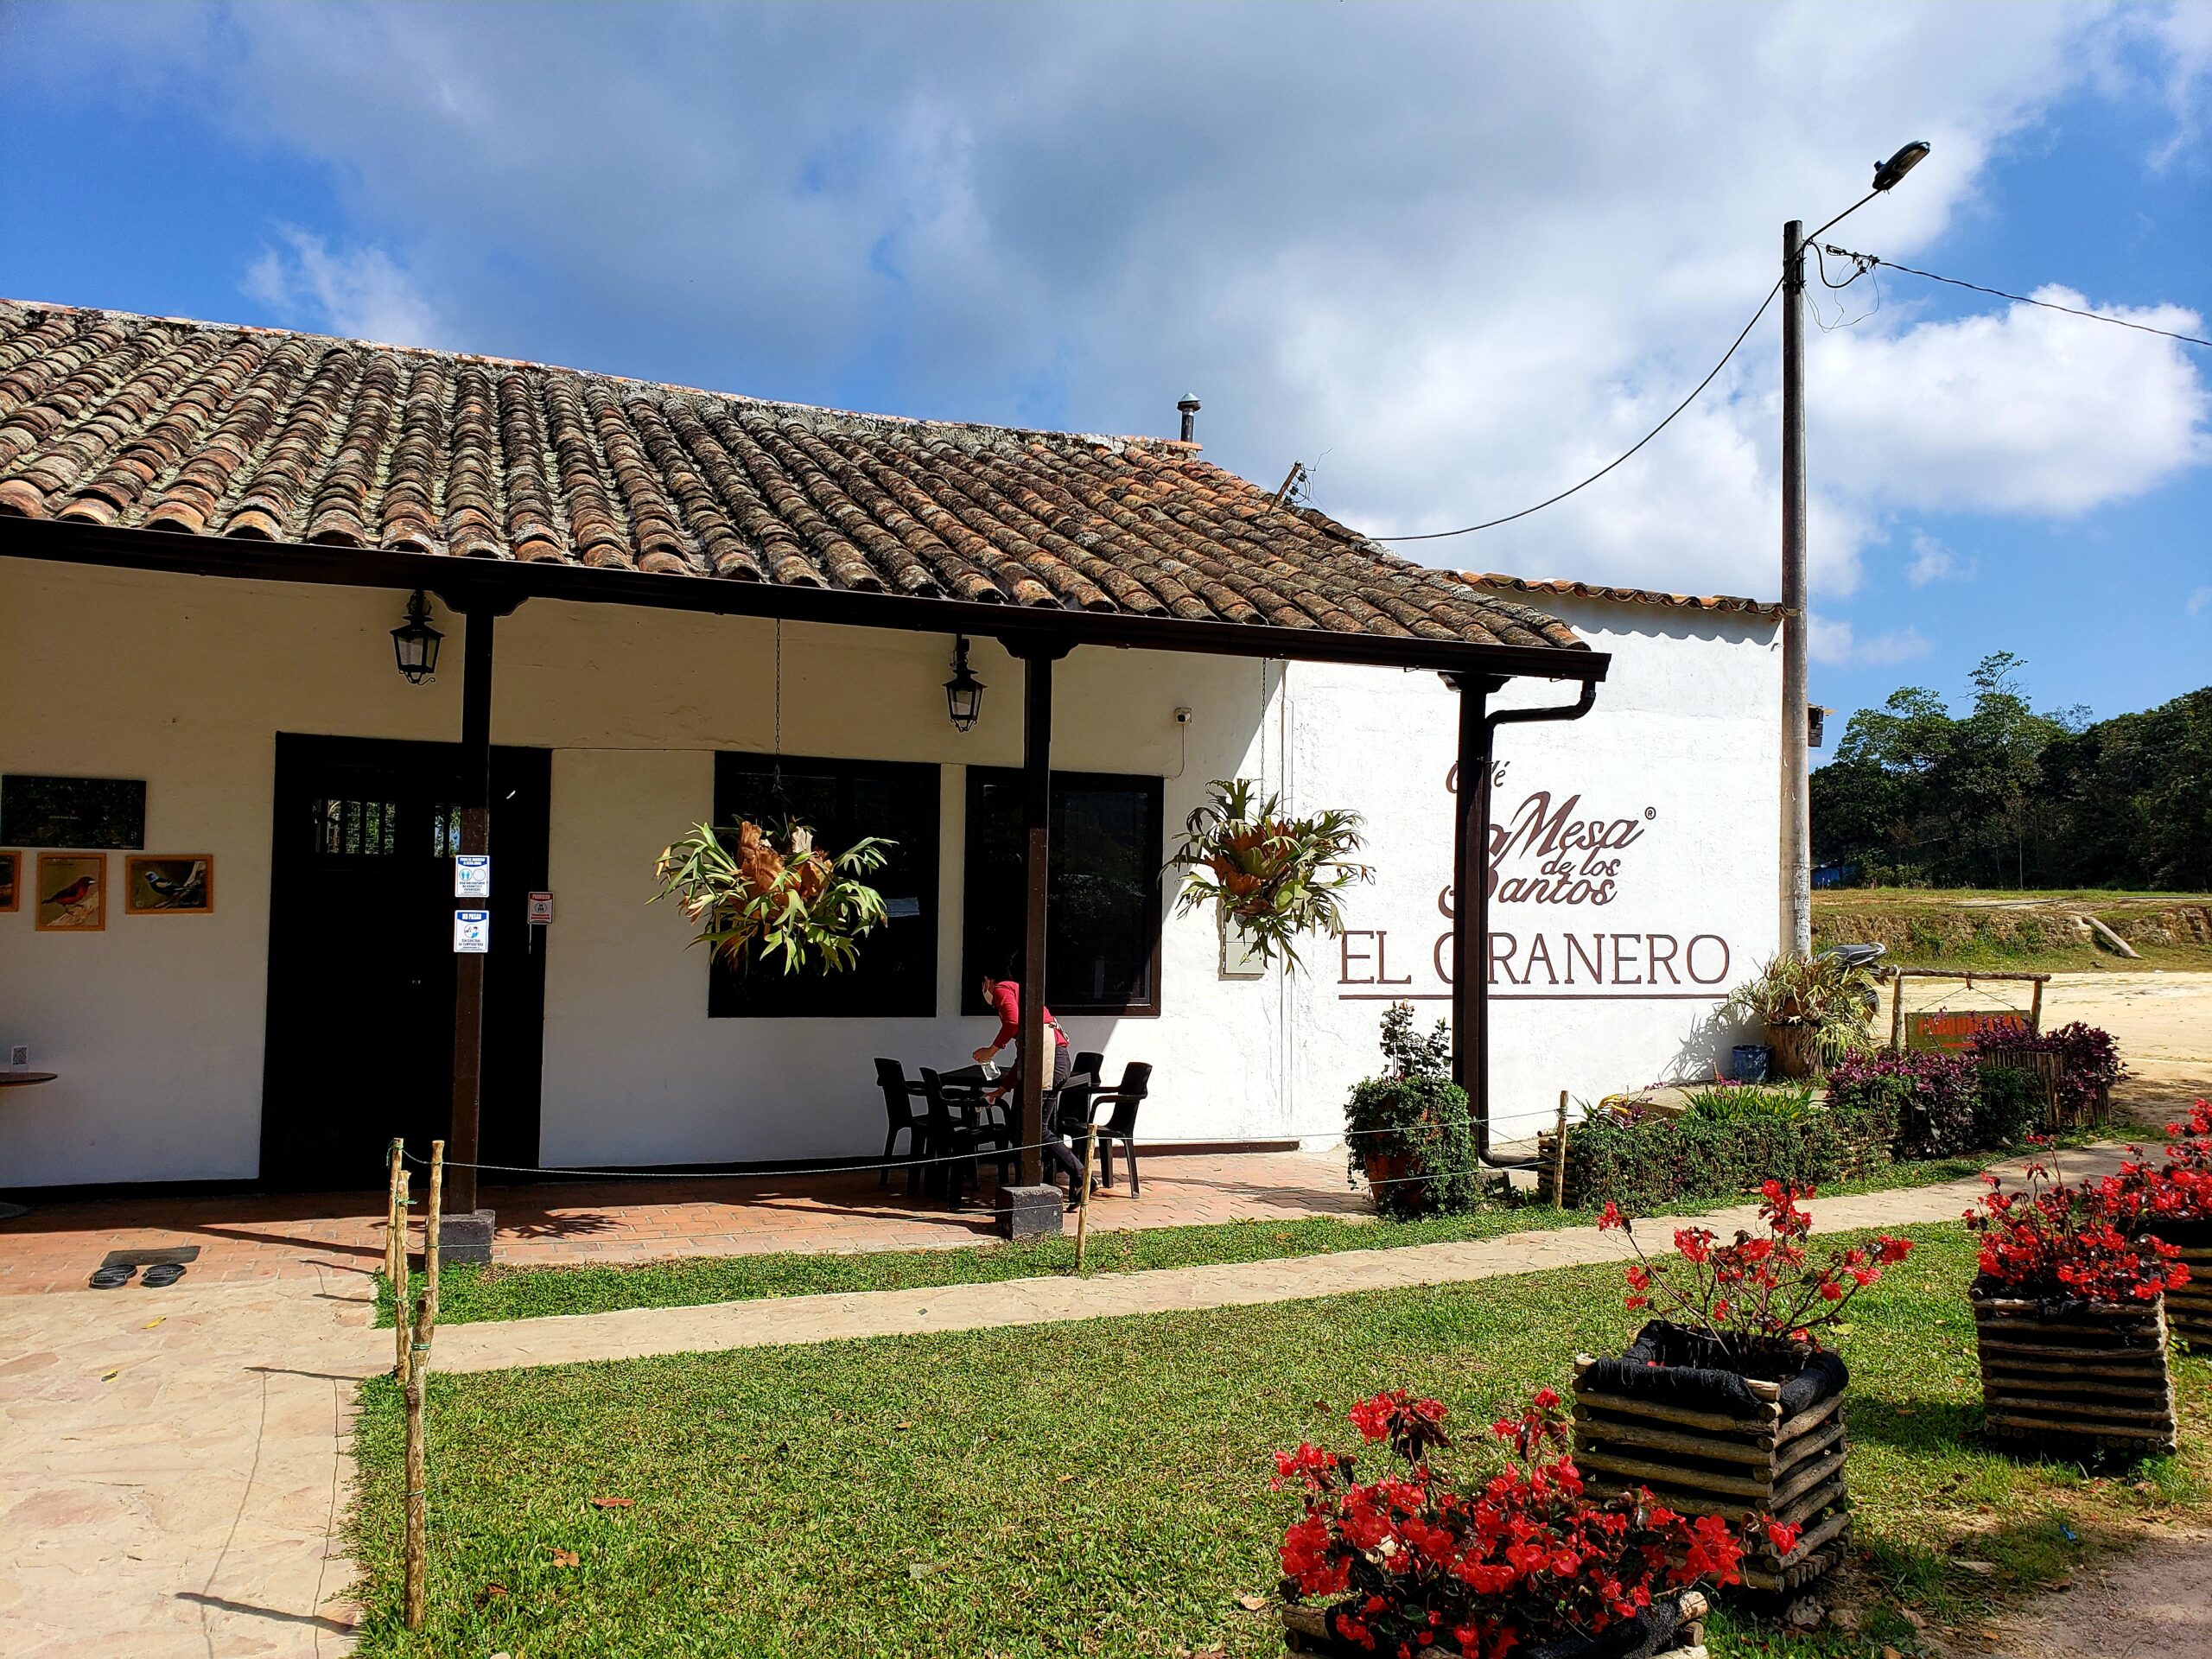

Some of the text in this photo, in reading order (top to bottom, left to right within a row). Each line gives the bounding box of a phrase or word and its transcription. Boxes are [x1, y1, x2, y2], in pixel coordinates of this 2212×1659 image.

[1505, 791, 1644, 860] Mesa
[1541, 845, 1621, 877] de los
[1338, 930, 1412, 984] EL
